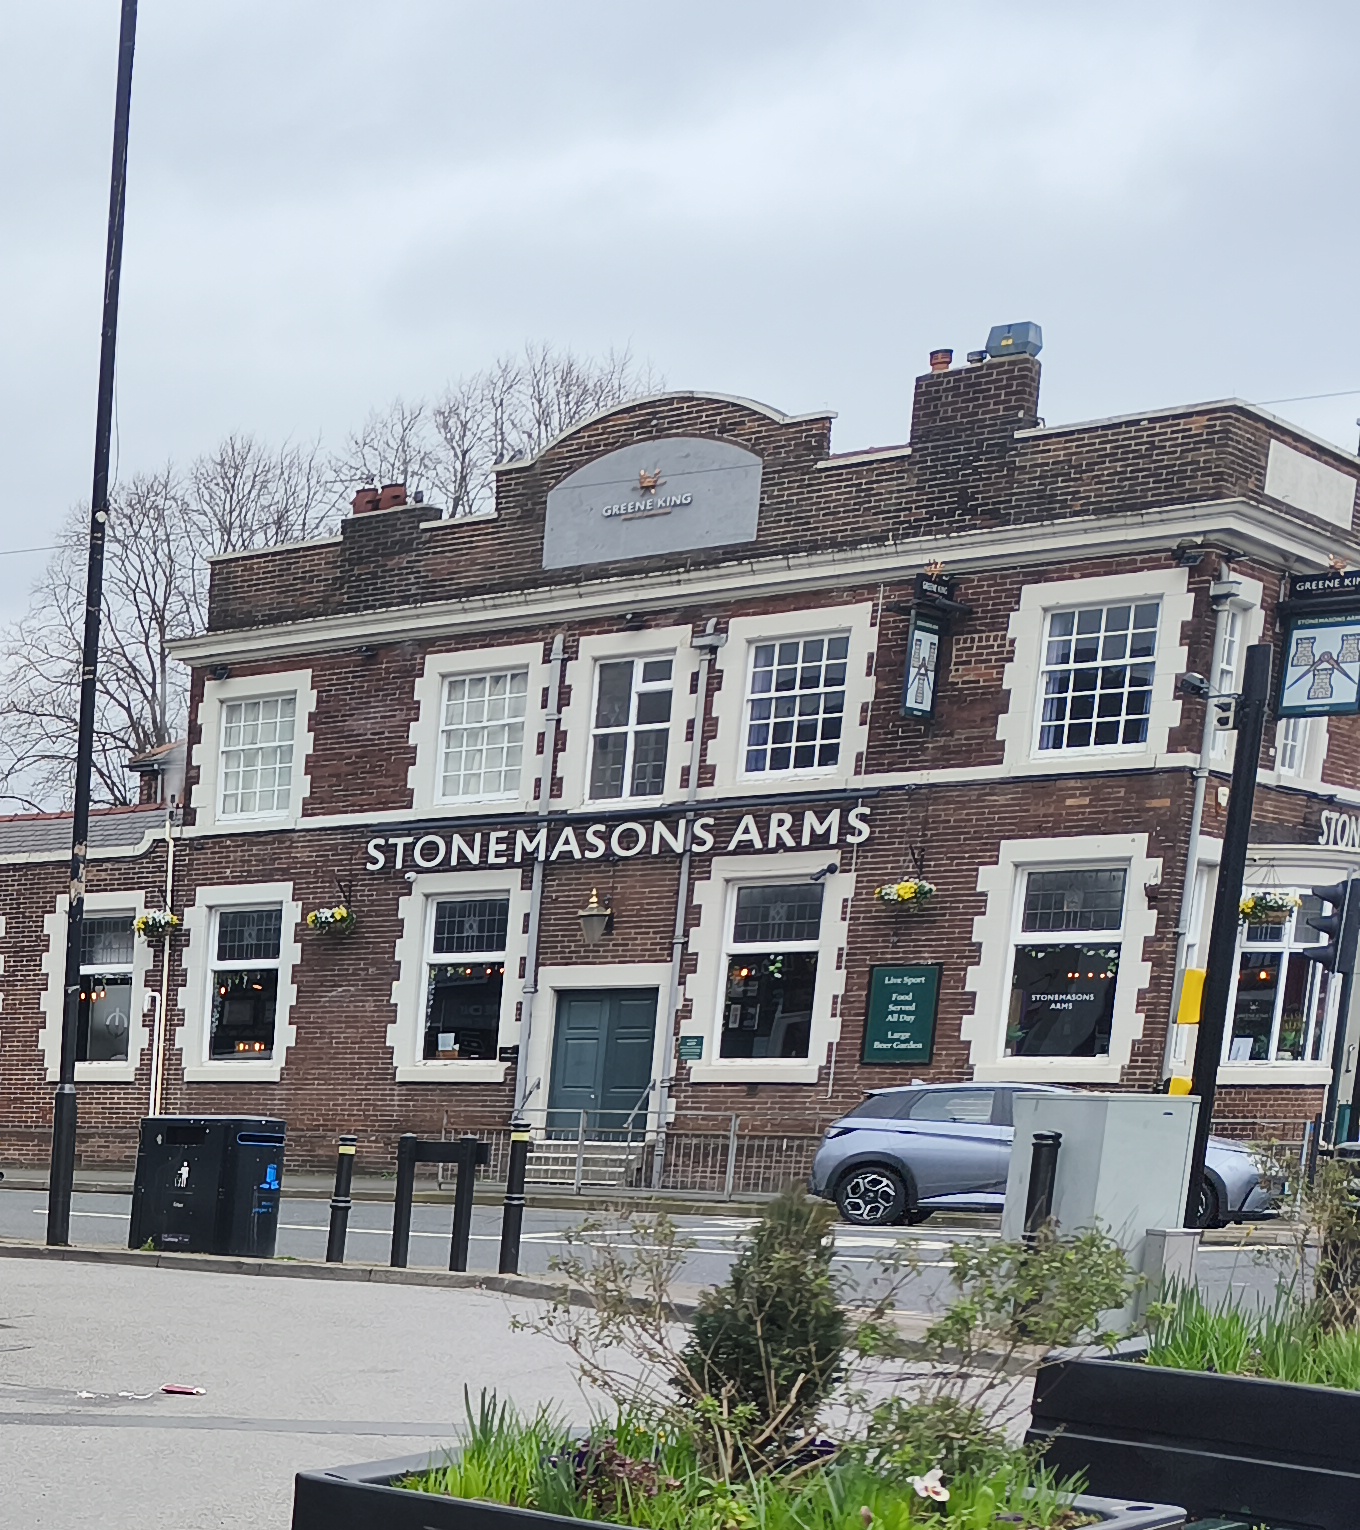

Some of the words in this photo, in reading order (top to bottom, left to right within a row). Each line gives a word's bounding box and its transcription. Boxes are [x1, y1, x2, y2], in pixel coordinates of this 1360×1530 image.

[602, 499, 654, 517] GREENE
[657, 493, 693, 508] KING
[1296, 578, 1341, 591] GREENE
[366, 816, 715, 872] STONEMASONS
[727, 806, 872, 850] ARMS
[884, 976, 902, 984] Live
[903, 976, 926, 985] Sport
[891, 992, 913, 1001] Food
[1031, 993, 1095, 1001] STONEMASONS
[888, 1003, 916, 1011] Served
[1049, 1002, 1073, 1010] ARMS
[886, 1013, 898, 1022] All
[899, 1014, 916, 1023] Day
[887, 1031, 911, 1040] Large
[873, 1041, 892, 1049] Beer
[893, 1041, 923, 1049] Garden
